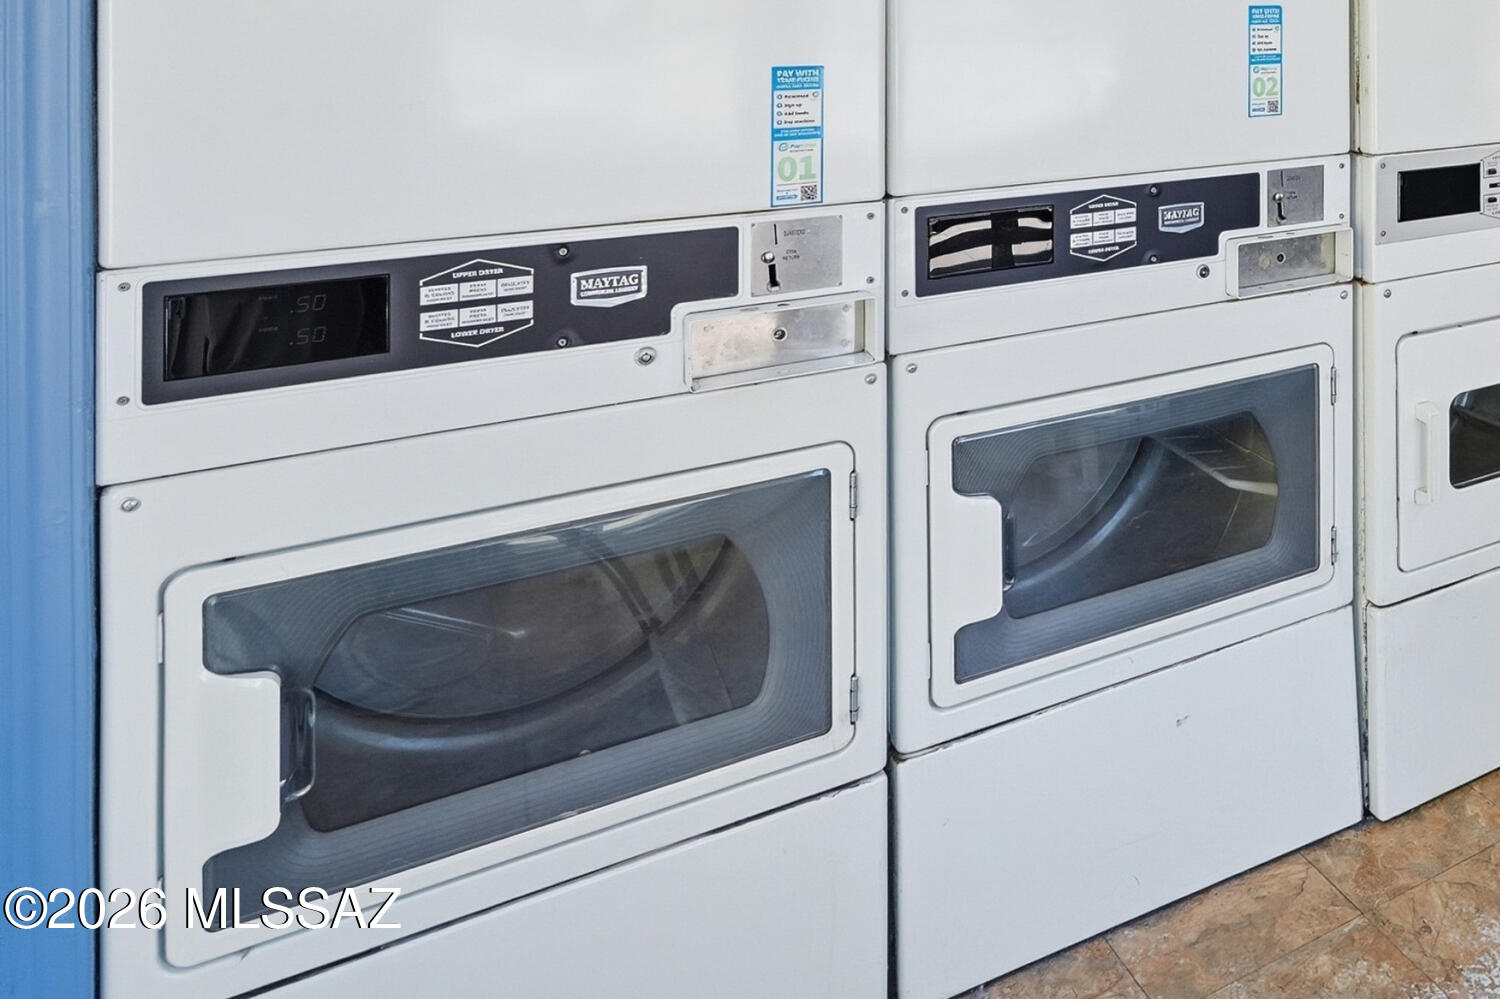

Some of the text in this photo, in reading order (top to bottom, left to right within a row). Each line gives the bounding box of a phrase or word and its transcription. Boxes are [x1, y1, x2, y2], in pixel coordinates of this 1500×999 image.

[1252, 76, 1279, 97] 02
[777, 156, 817, 181] 01
[452, 270, 478, 279] UPPER
[580, 273, 639, 290] MAYTAG
[450, 326, 505, 339] LOWER DRYER
